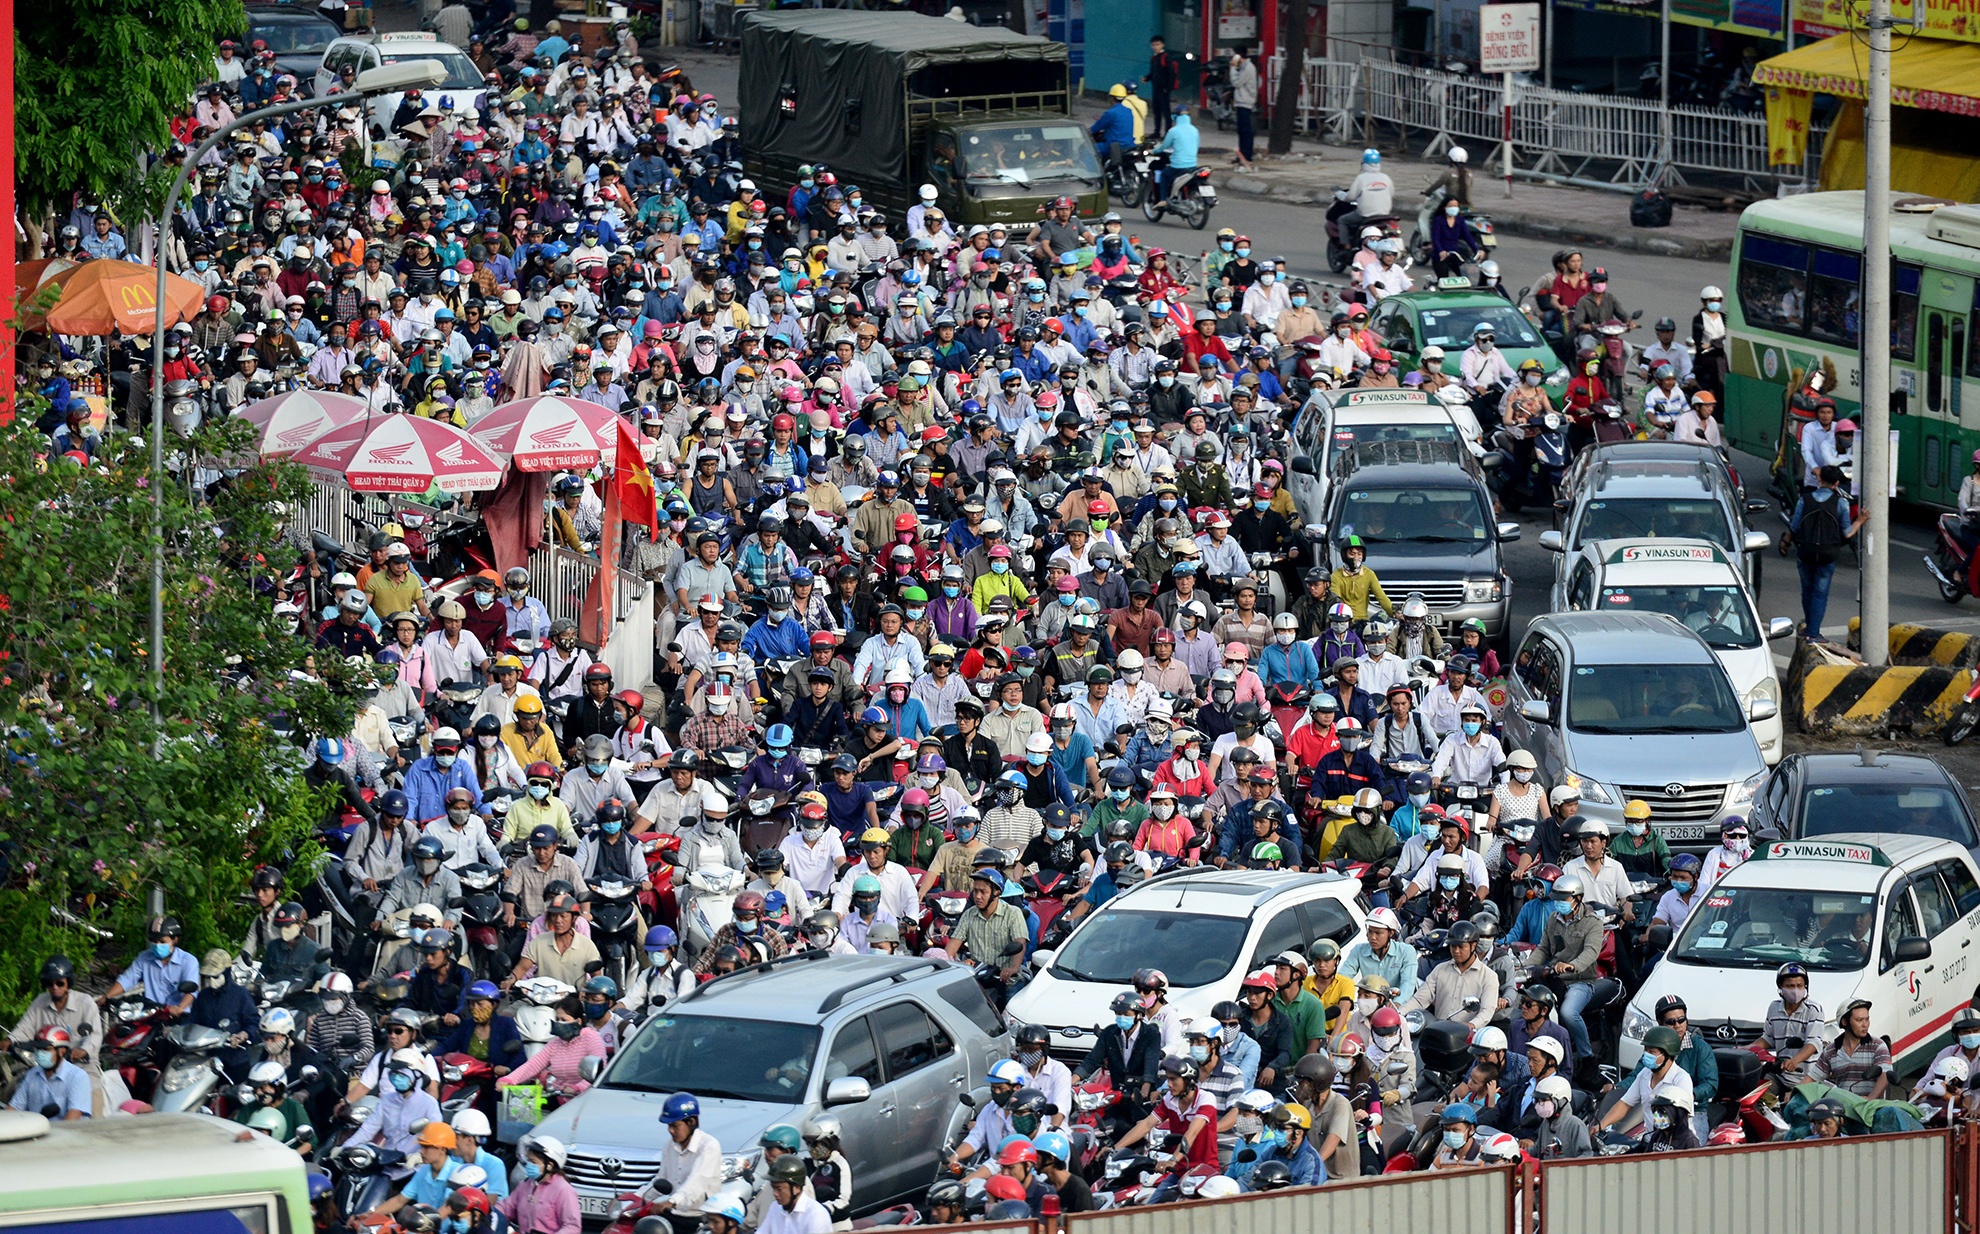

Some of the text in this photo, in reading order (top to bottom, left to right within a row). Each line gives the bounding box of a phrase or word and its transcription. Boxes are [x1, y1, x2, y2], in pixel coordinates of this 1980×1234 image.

[127, 307, 157, 316] McDonal
[1368, 392, 1426, 401] VINASUN TAXI
[531, 442, 582, 450] HONDA
[441, 459, 480, 467] HONDA
[521, 459, 539, 468] HEAD
[589, 456, 595, 464] 3
[355, 477, 371, 486] HEAD
[420, 479, 425, 488] 3
[1645, 549, 1711, 558] VINASUN TAXI
[1609, 595, 1630, 603] 4350
[1655, 827, 1703, 839] 1F-526.32
[1793, 845, 1870, 861] VINASUN TAXI
[1707, 898, 1730, 906] 7544
